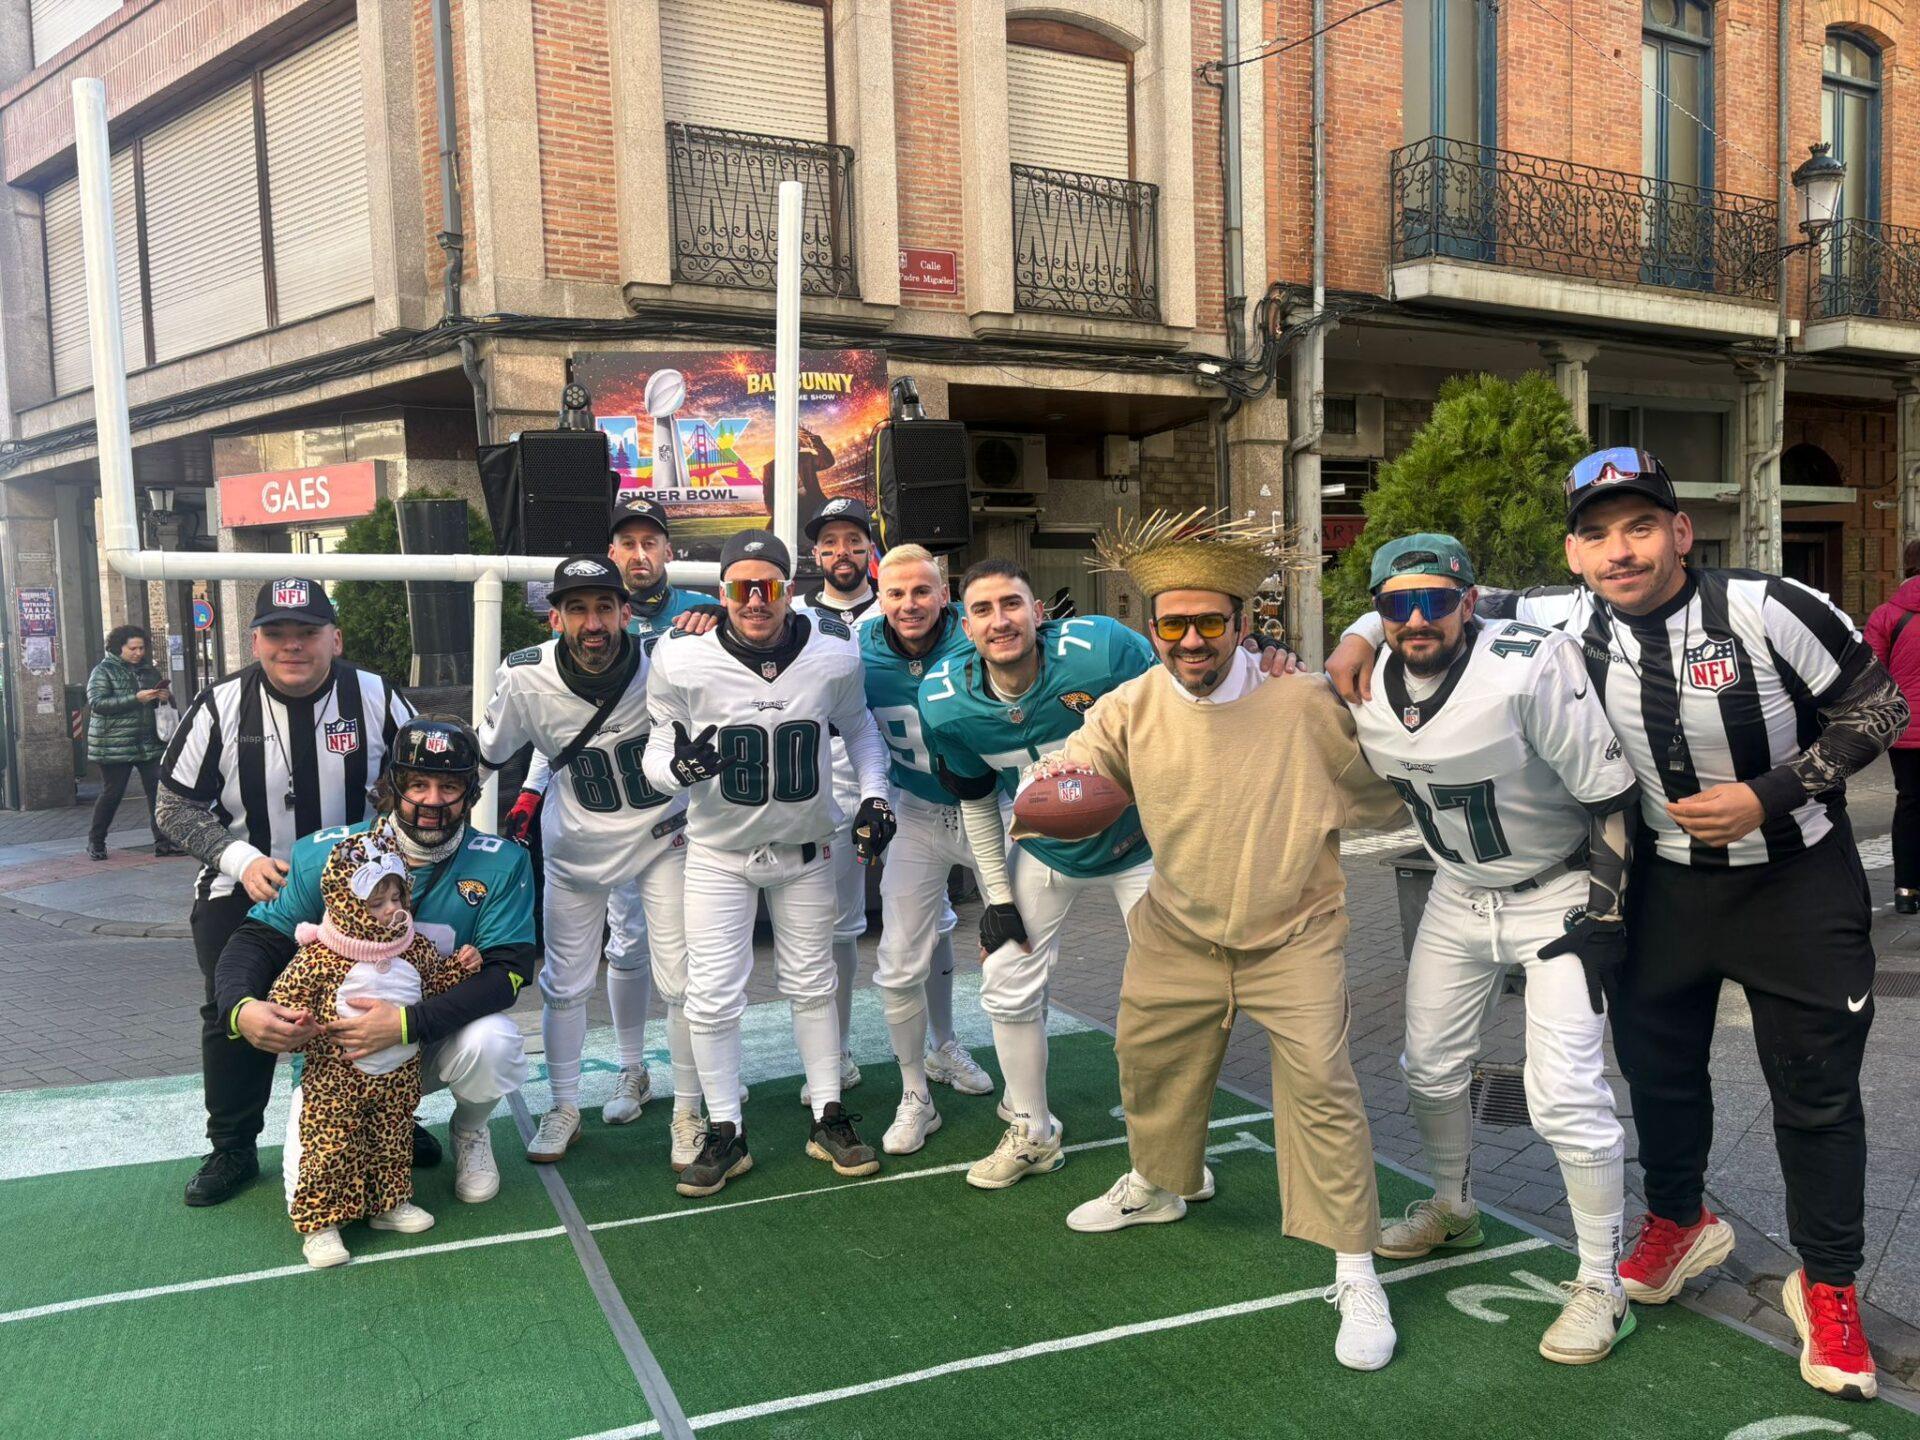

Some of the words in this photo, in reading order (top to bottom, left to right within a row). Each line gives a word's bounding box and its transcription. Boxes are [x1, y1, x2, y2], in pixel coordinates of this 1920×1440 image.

[920, 260, 941, 271] Calle
[747, 372, 776, 394] BA
[798, 371, 854, 394] UNNY
[261, 475, 330, 514] GAES
[619, 490, 681, 501] SUPER
[686, 489, 739, 500] BOWL
[277, 590, 305, 604] NFL
[1058, 619, 1094, 656] 77
[1490, 622, 1553, 660] 17
[1691, 660, 1734, 687] NFL
[328, 733, 356, 751] NFL
[427, 739, 447, 751] NFL
[568, 733, 680, 814] 88
[718, 719, 820, 807] 80
[1061, 789, 1080, 800] NFL
[1386, 774, 1512, 865] 17
